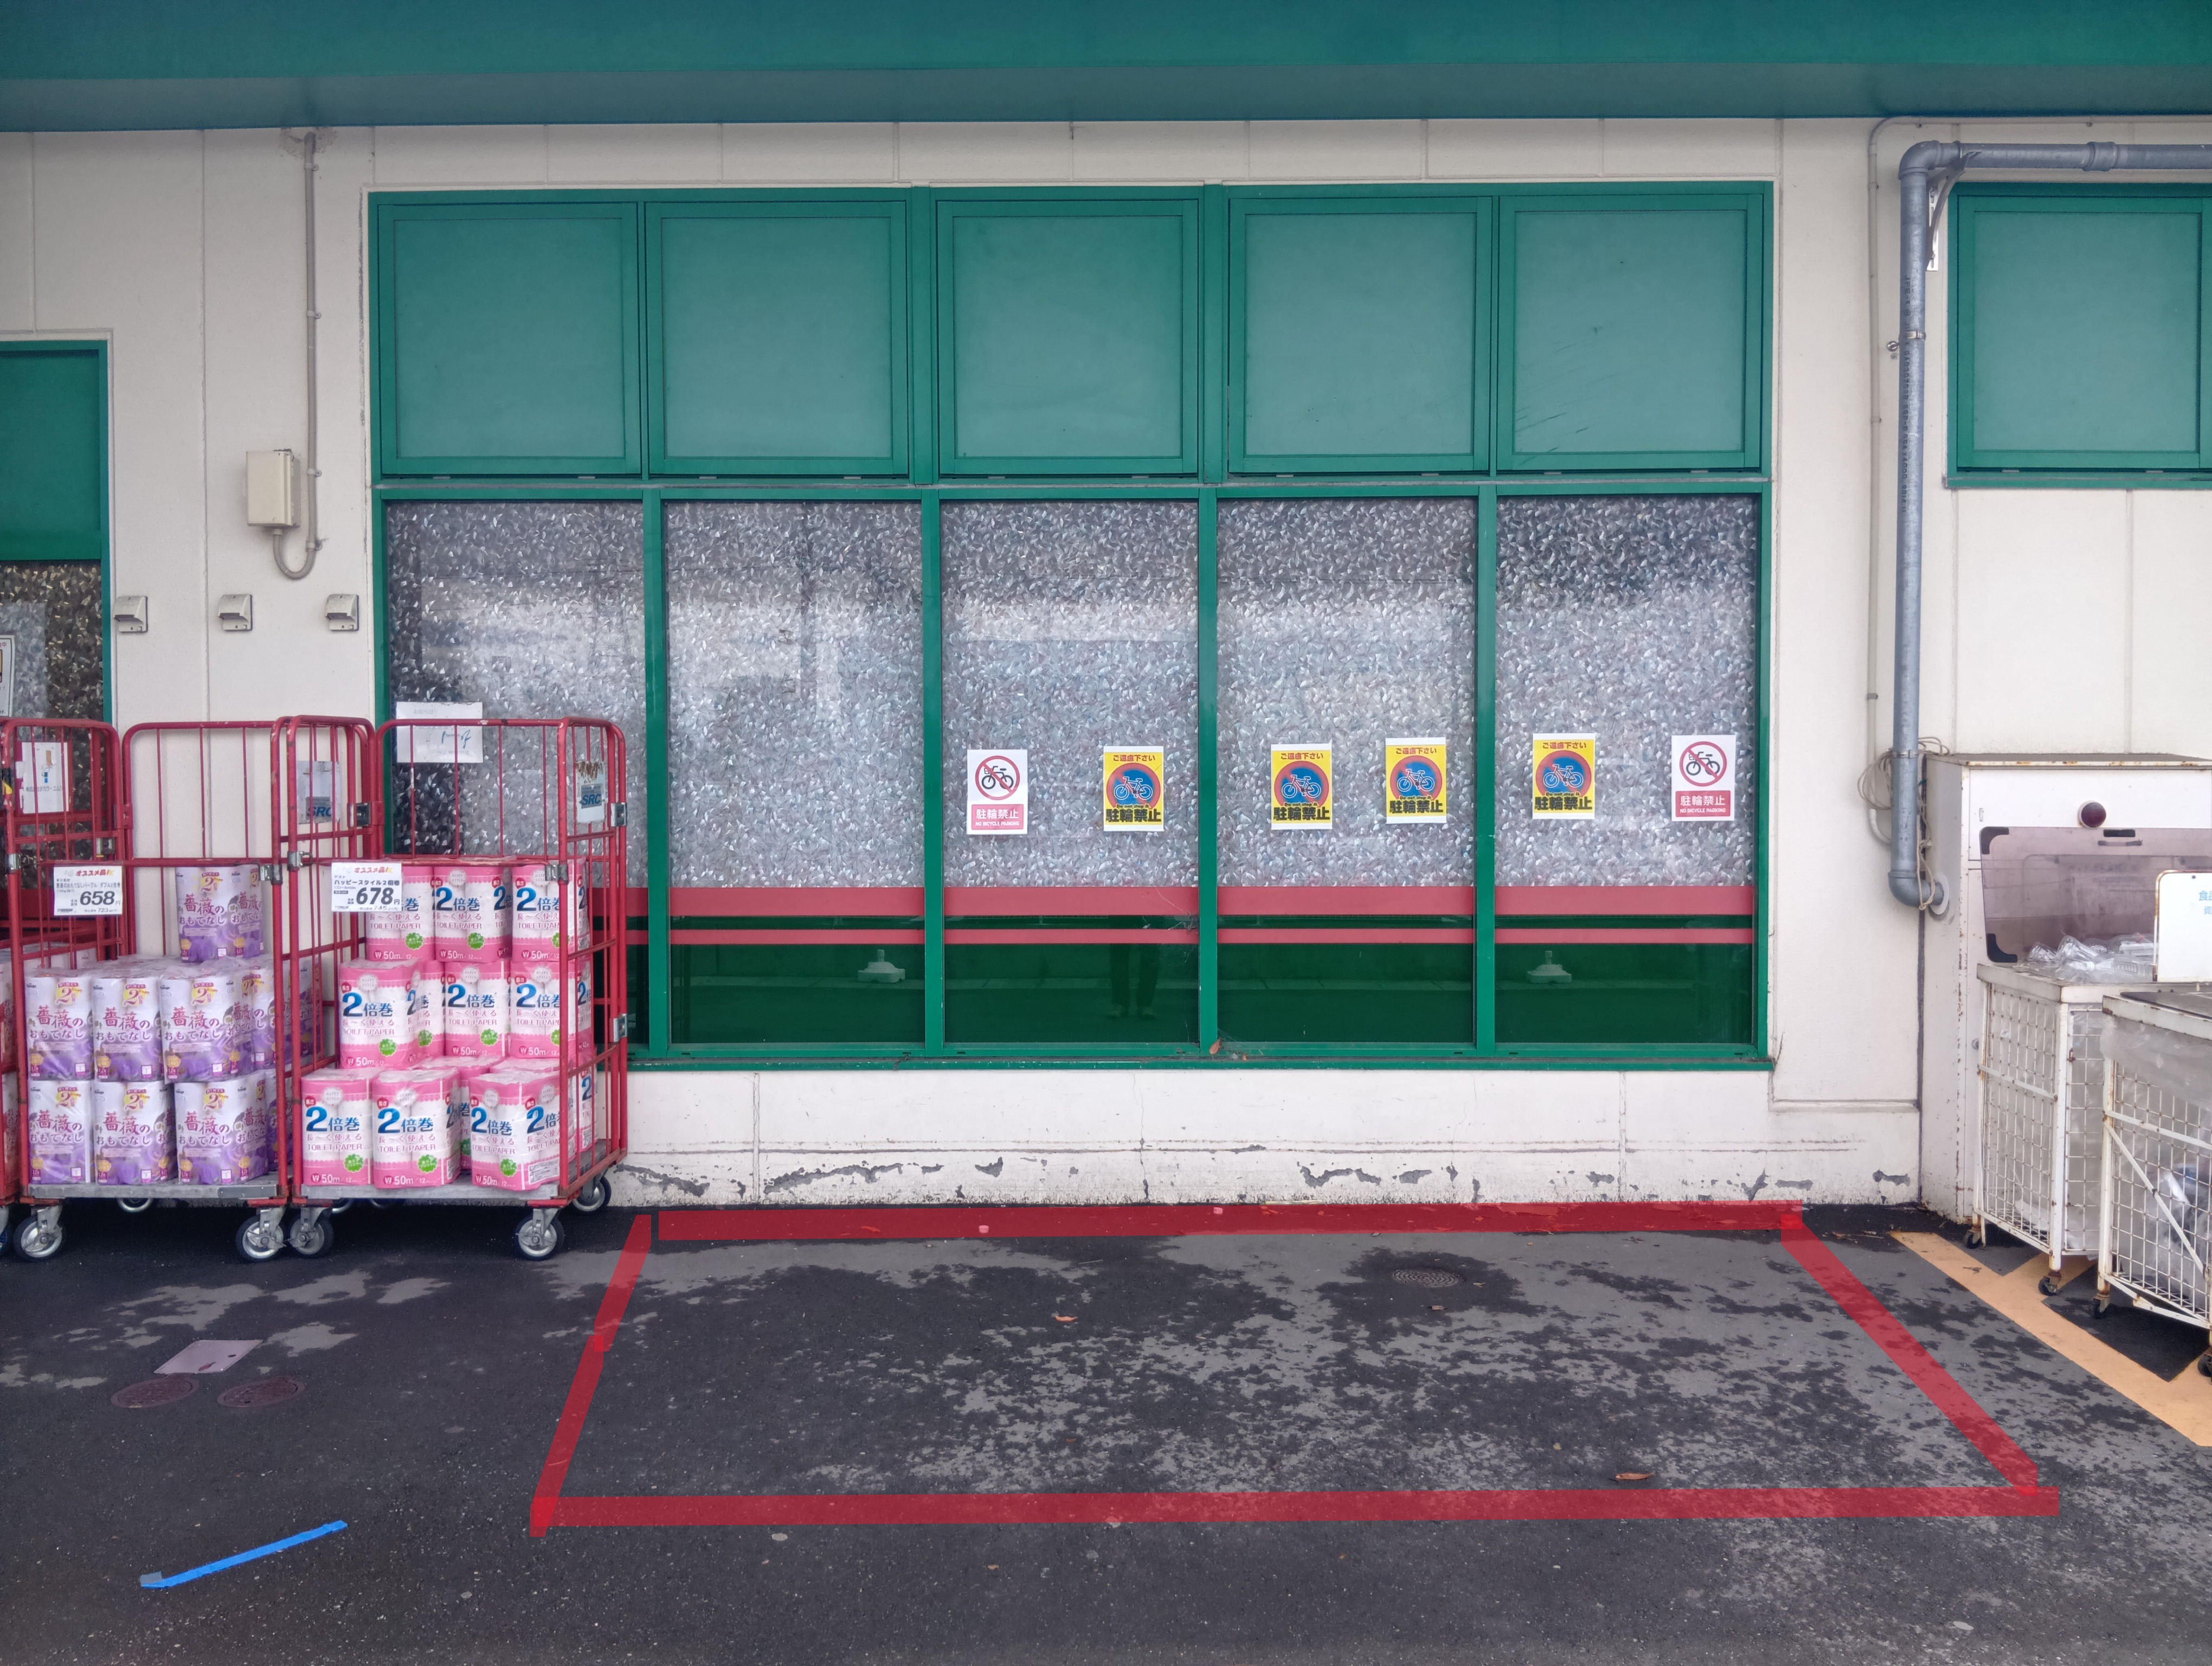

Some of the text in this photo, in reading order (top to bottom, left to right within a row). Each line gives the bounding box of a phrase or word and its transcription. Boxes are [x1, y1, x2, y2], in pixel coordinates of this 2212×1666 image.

[581, 793, 602, 806] SRC
[1389, 799, 1443, 813] 駐輪禁止
[1534, 796, 1592, 810] 駐輪禁止
[1680, 795, 1726, 806] 駐輪禁止
[976, 809, 1019, 819] 駐輪禁止
[1105, 808, 1161, 822] 駐輪禁止
[1273, 806, 1330, 821] 駐輪禁止
[184, 893, 224, 915] 薔薇の
[436, 887, 480, 911] 2倍巻
[179, 917, 225, 925] おもてなし
[447, 984, 495, 1008] 2倍巻
[342, 992, 393, 1017] 2倍巻
[36, 1005, 83, 1028] 薔薇の
[102, 1007, 151, 1030] 薔薇の
[171, 1007, 220, 1029] 薔薇の
[30, 1029, 83, 1039] おもてなし
[96, 1031, 151, 1041] おもてなし
[165, 1031, 220, 1041] おもてなし
[37, 1110, 82, 1132] 薔薇の
[103, 1112, 150, 1135] 薔薇の
[184, 1111, 230, 1135] 薔薇の
[306, 1106, 360, 1132] 2倍巻
[378, 1107, 434, 1133] 2倍巻
[471, 1107, 512, 1136] 2倍巻
[526, 1106, 560, 1134] 2倍
[30, 1133, 82, 1142] おもてなし
[97, 1136, 151, 1145] おもてなし
[179, 1136, 230, 1145] おもてなし
[409, 1144, 436, 1152] PAPER
[493, 1146, 515, 1155] PAPER
[528, 1142, 548, 1152] TOILET
